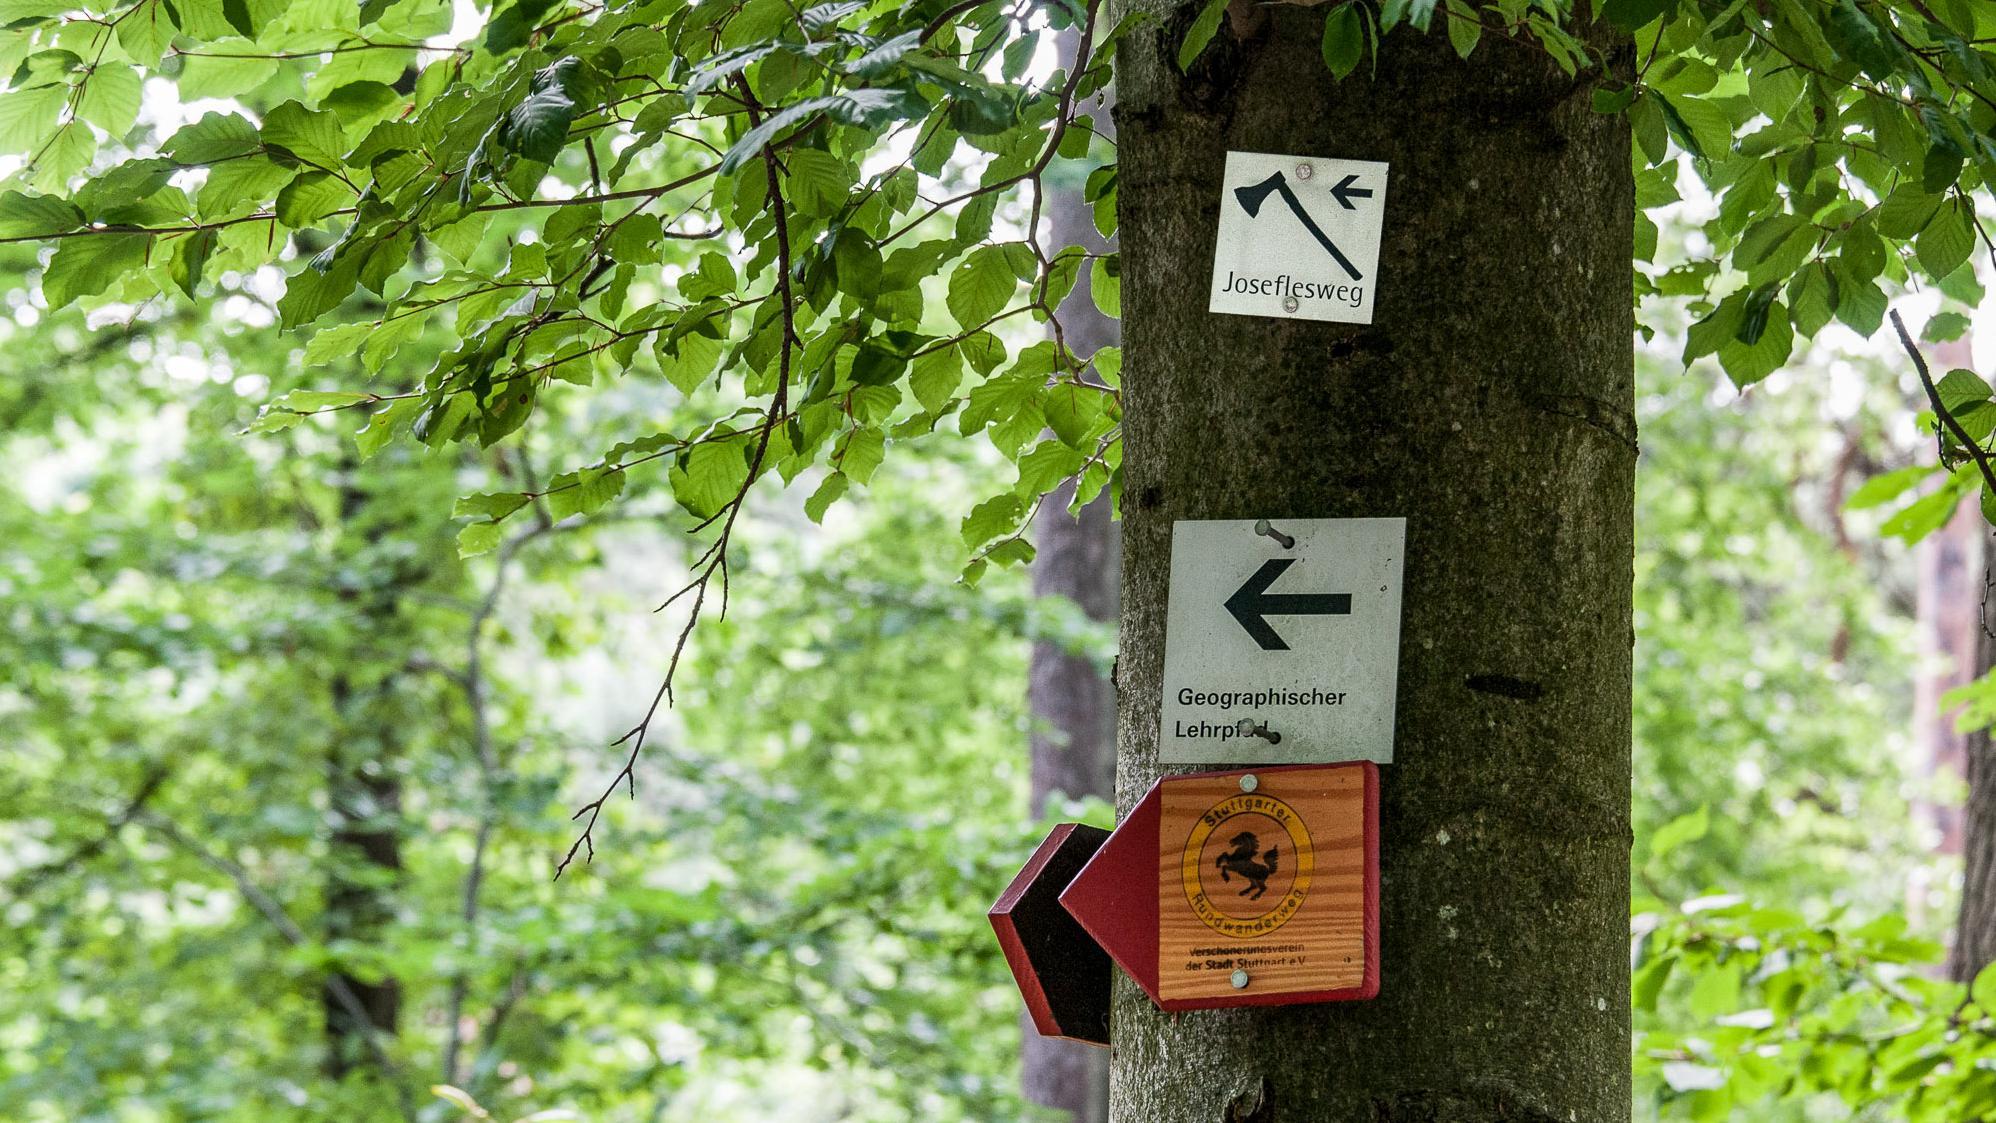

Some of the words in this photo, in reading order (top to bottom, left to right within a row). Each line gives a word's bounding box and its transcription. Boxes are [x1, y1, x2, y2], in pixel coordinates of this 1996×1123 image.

[1222, 271, 1363, 307] Joseflesweg
[1177, 688, 1347, 709] Geographischer
[1175, 720, 1268, 741] Lehrpf
[1204, 799, 1291, 827] Stuttgarter
[1193, 889, 1304, 934] Rundwanderweg
[1185, 960, 1203, 971] der
[1205, 959, 1233, 970] Stadt
